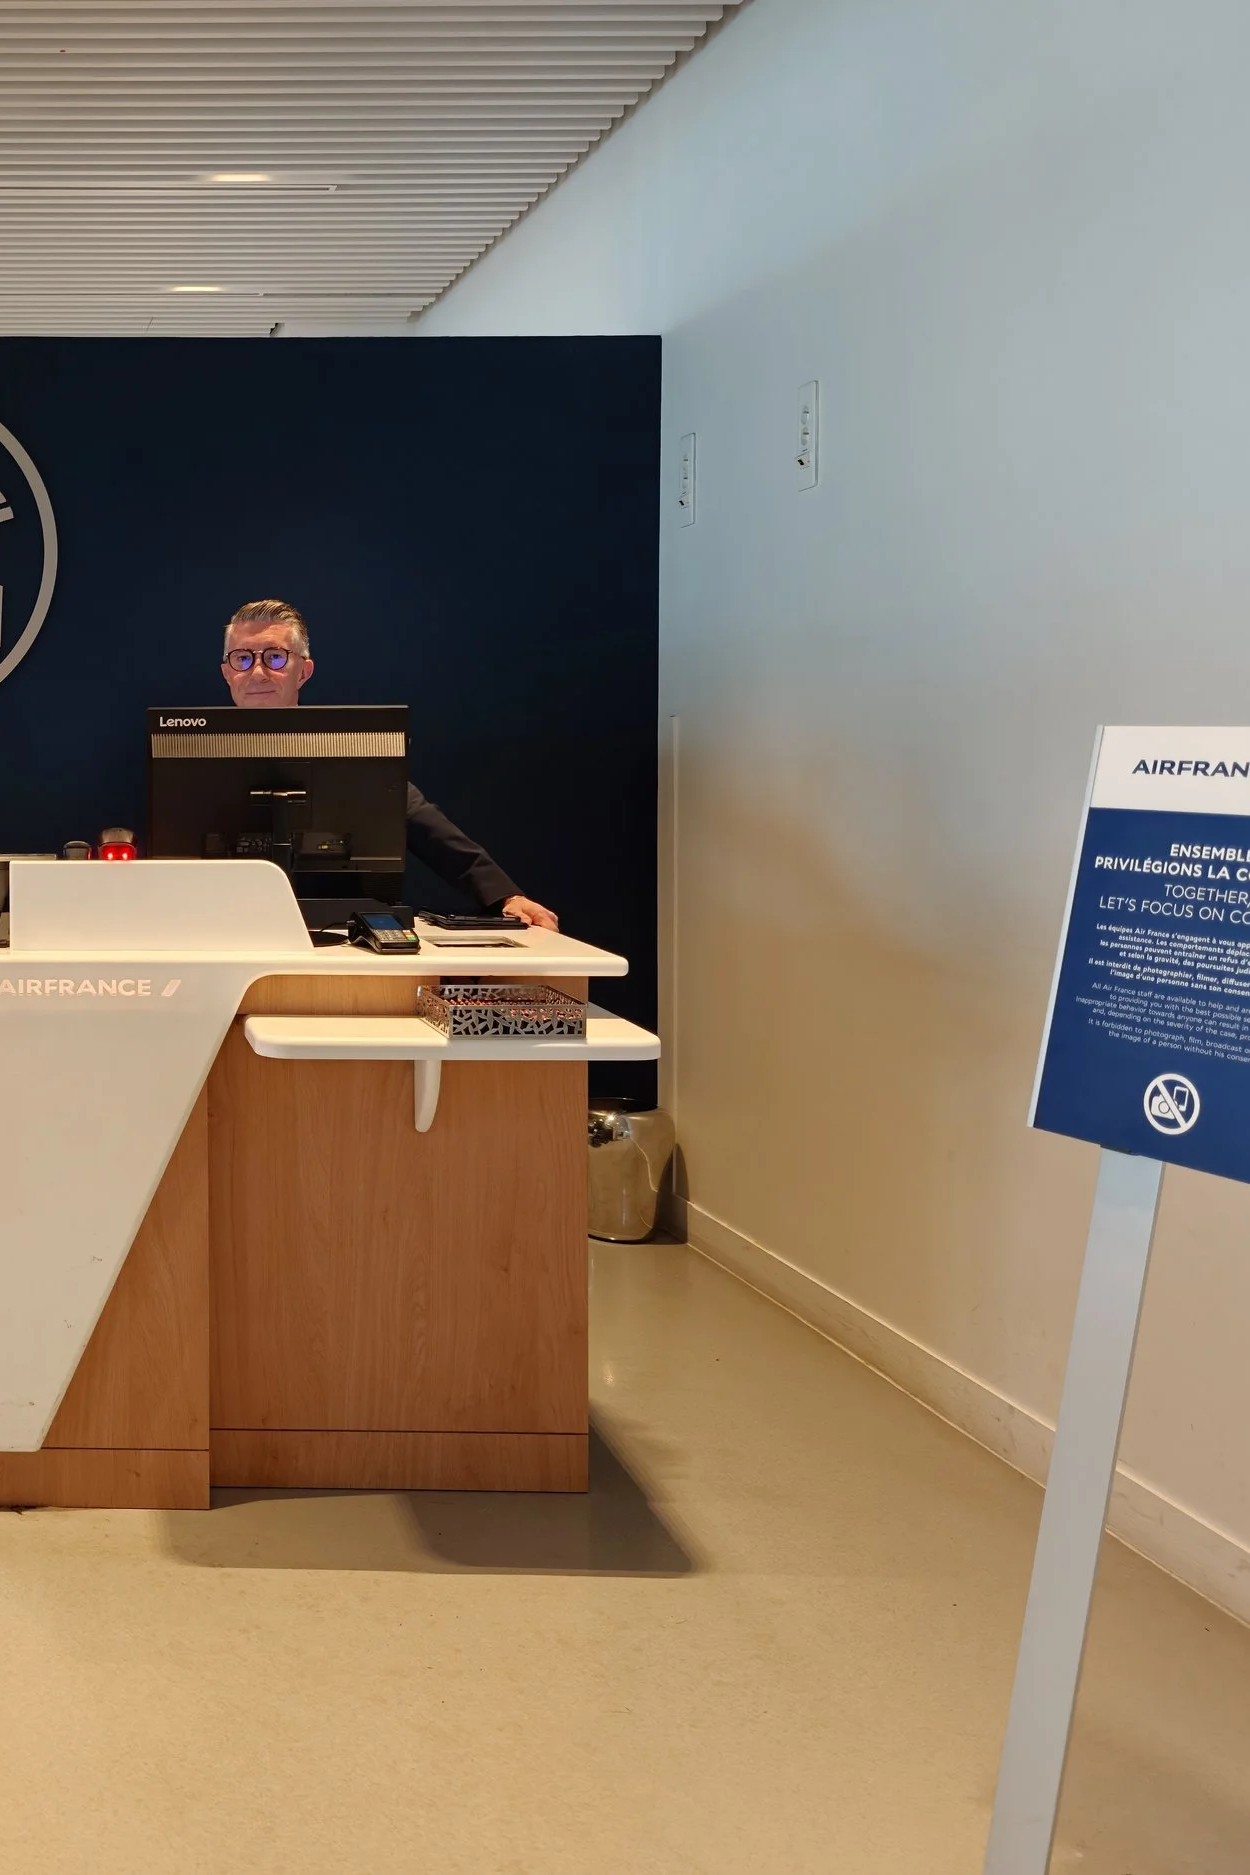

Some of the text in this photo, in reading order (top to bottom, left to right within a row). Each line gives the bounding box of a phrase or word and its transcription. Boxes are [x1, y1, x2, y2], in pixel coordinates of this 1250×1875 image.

[159, 716, 207, 727] Lenovo
[1132, 759, 1250, 777] AIRFRAN
[1095, 856, 1250, 881] PRIVILÉGIONS LA C
[1099, 896, 1136, 911] LET'S
[1141, 900, 1193, 918] FOCUS
[1199, 906, 1225, 921] ON
[1108, 924, 1133, 934] équipes
[1147, 929, 1169, 938] France
[1172, 933, 1210, 943] s'engagent
[1118, 935, 1154, 944] assistance.
[1169, 941, 1224, 953] comportements
[1110, 942, 1142, 951] personnes
[1144, 946, 1172, 955] peuvent
[1106, 960, 1131, 969] interdit
[1142, 966, 1194, 980] photographier,
[1197, 973, 1219, 984] filmer,
[1154, 956, 1181, 966] gravité,
[1196, 962, 1234, 972] poursuites
[1110, 969, 1134, 979] l'image
[1136, 973, 1155, 981] d'une
[1156, 977, 1188, 987] personne
[1191, 982, 1206, 990] sans
[1114, 986, 1136, 995] France
[1167, 995, 1196, 1005] available
[1208, 1001, 1223, 1010] help
[1118, 996, 1148, 1006] providing
[1150, 1000, 1162, 1008] you
[1196, 1008, 1211, 1016] best
[1213, 1012, 1241, 1022] possible
[1076, 996, 1117, 1008] Inappropriate
[1119, 1003, 1146, 1013] behavior
[1148, 1008, 1175, 1018] towards
[1177, 1014, 1202, 1023] anyone
[1219, 1021, 1240, 1030] result
[1107, 1010, 1141, 1022] depending
[1167, 1021, 1193, 1031] severity
[1205, 1027, 1217, 1035] the
[1219, 1030, 1237, 1039] case,
[1102, 1020, 1132, 1032] forbidden
[1144, 1028, 1186, 1043] photograph,
[1189, 1037, 1203, 1046] film,
[1206, 1040, 1242, 1052] broadcast
[1121, 1032, 1141, 1043] image
[1158, 1041, 1182, 1049] person
[1184, 1045, 1212, 1055] without
